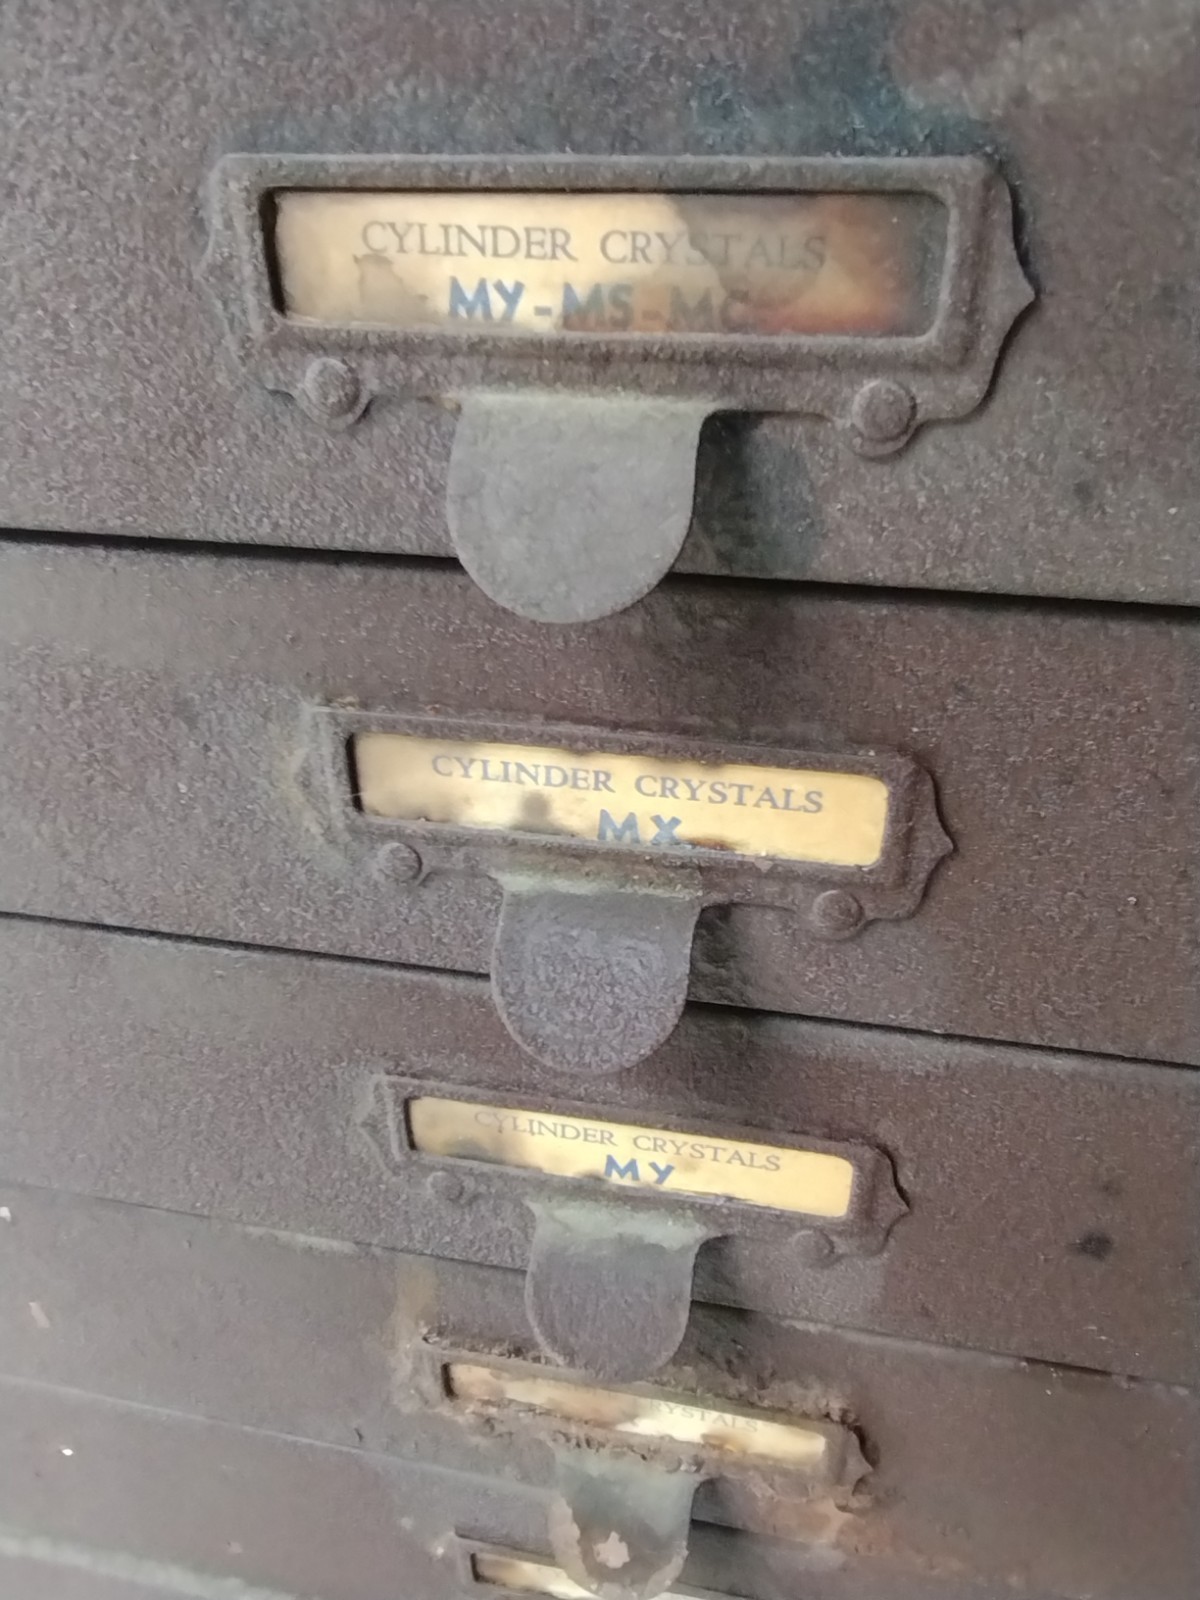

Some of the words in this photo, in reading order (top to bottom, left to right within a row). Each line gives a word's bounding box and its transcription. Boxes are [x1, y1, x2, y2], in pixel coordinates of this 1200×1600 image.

[360, 219, 576, 260] CYLINDER
[599, 231, 827, 271] CRYSTALS
[432, 754, 614, 792] CYLINDER
[634, 775, 823, 815] CRYSTALS
[598, 808, 682, 846] MX
[475, 1111, 616, 1146] CYLINDER
[633, 1136, 781, 1172] CRYSTALS
[604, 1155, 675, 1185] MY
